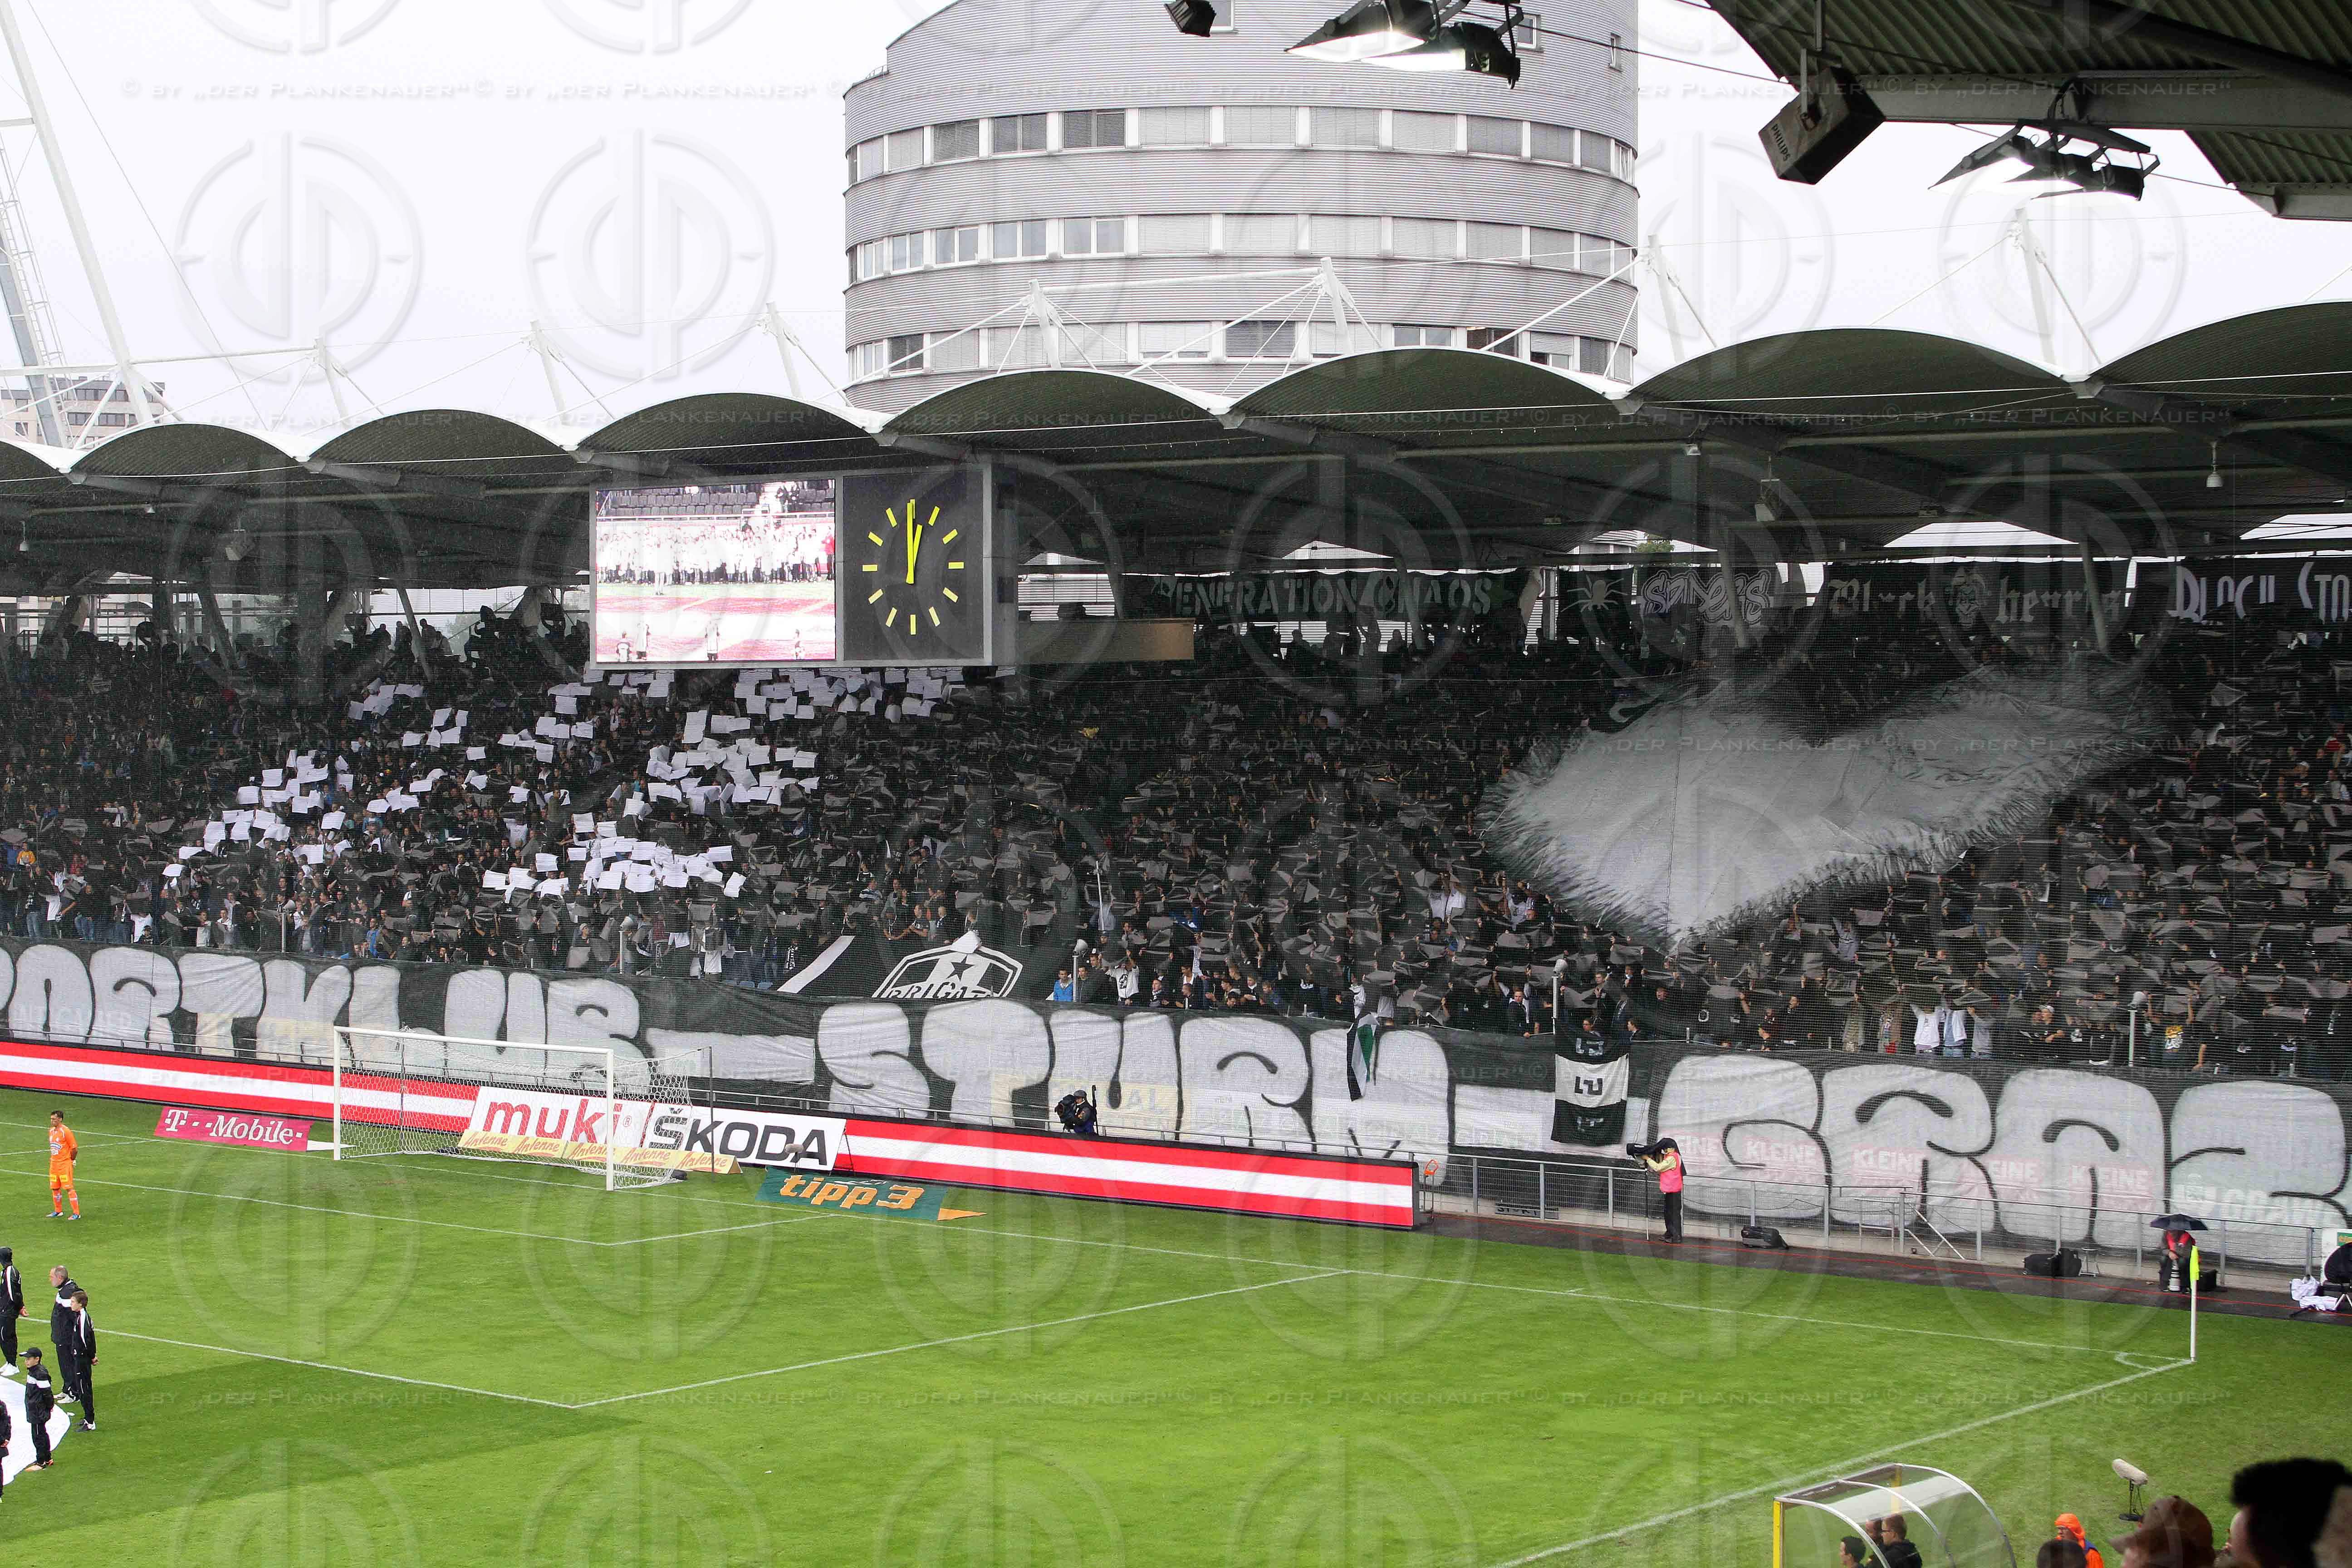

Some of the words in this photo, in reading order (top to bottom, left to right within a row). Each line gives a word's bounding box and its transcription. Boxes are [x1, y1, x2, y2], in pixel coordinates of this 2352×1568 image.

[1771, 123, 1790, 161] PHILIPS
[1154, 577, 1357, 616] ENERATION
[464, 1132, 508, 1147] Antenne
[514, 1137, 560, 1154] Antenne
[649, 1107, 828, 1166] ŠKODA
[1674, 1135, 1720, 1157] EINE
[622, 1148, 671, 1165] Antenne
[680, 1152, 727, 1169] Antenne
[1745, 1140, 1817, 1164] KLEINE
[2072, 1165, 2149, 1191] KEINE
[780, 1175, 925, 1209] tipp3
